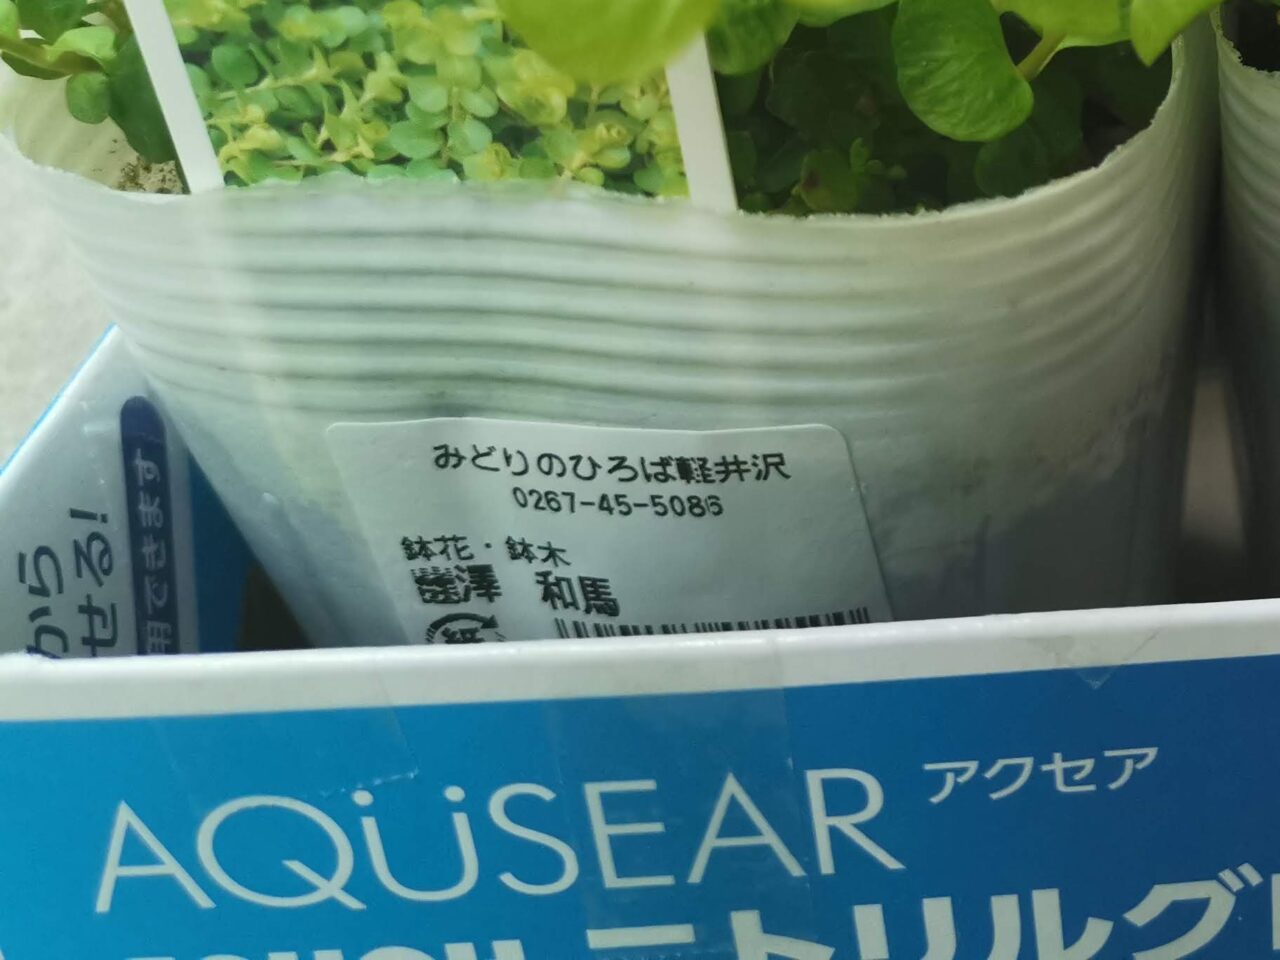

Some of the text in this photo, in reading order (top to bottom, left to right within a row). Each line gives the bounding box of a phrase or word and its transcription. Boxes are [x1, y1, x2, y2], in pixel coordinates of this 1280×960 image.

[433, 442, 791, 486] みどりのひろば軽井沢
[512, 486, 724, 518] 0267-45-5086
[535, 570, 620, 617] 和馬
[923, 746, 1160, 805] アクセア
